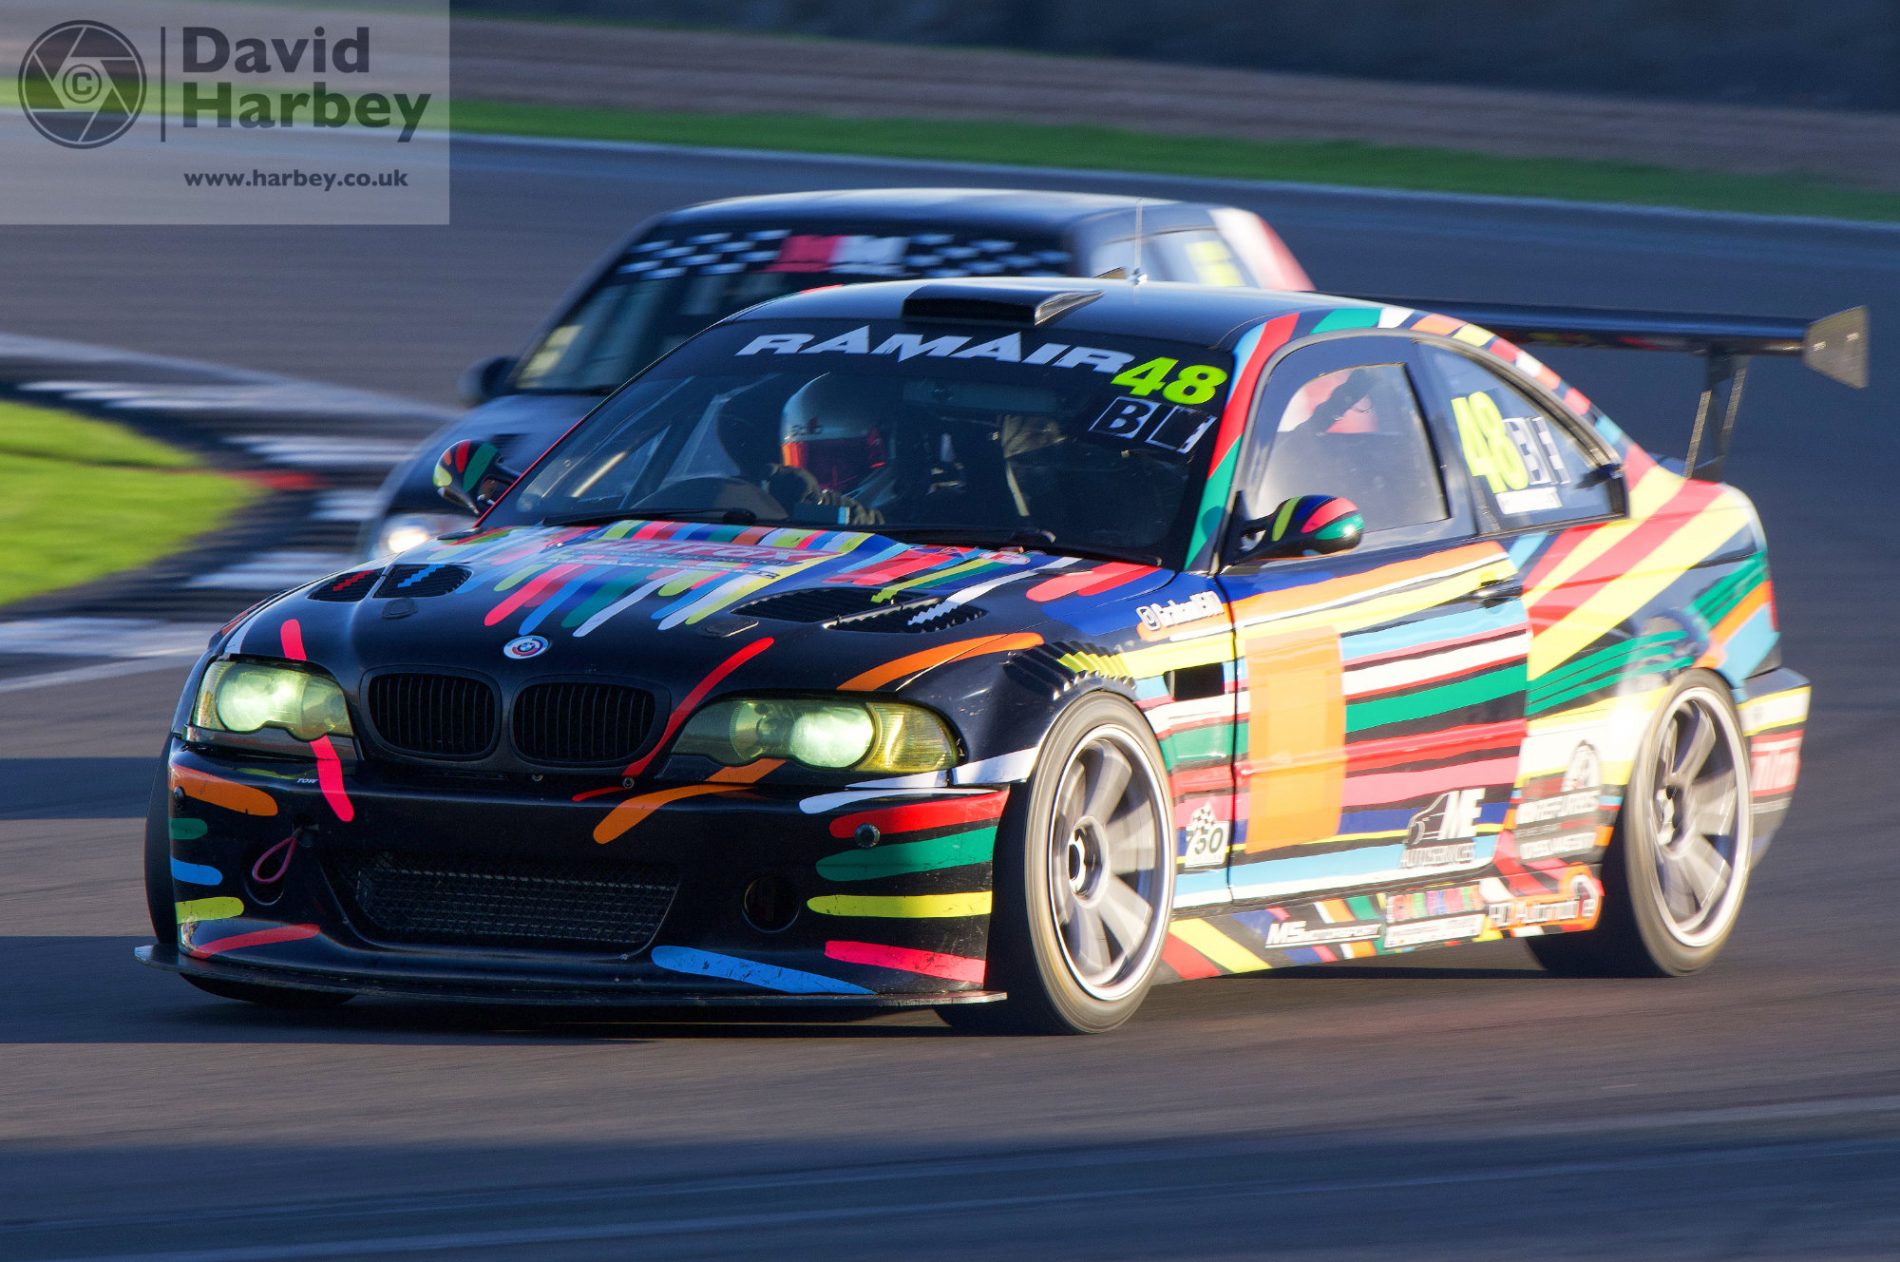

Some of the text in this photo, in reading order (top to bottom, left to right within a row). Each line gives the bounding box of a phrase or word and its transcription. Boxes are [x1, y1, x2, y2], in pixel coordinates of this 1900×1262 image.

[735, 325, 1136, 374] RAMAIR
[1110, 356, 1228, 404] 48
[1451, 391, 1529, 494] 48
[1437, 788, 1486, 840] ME
